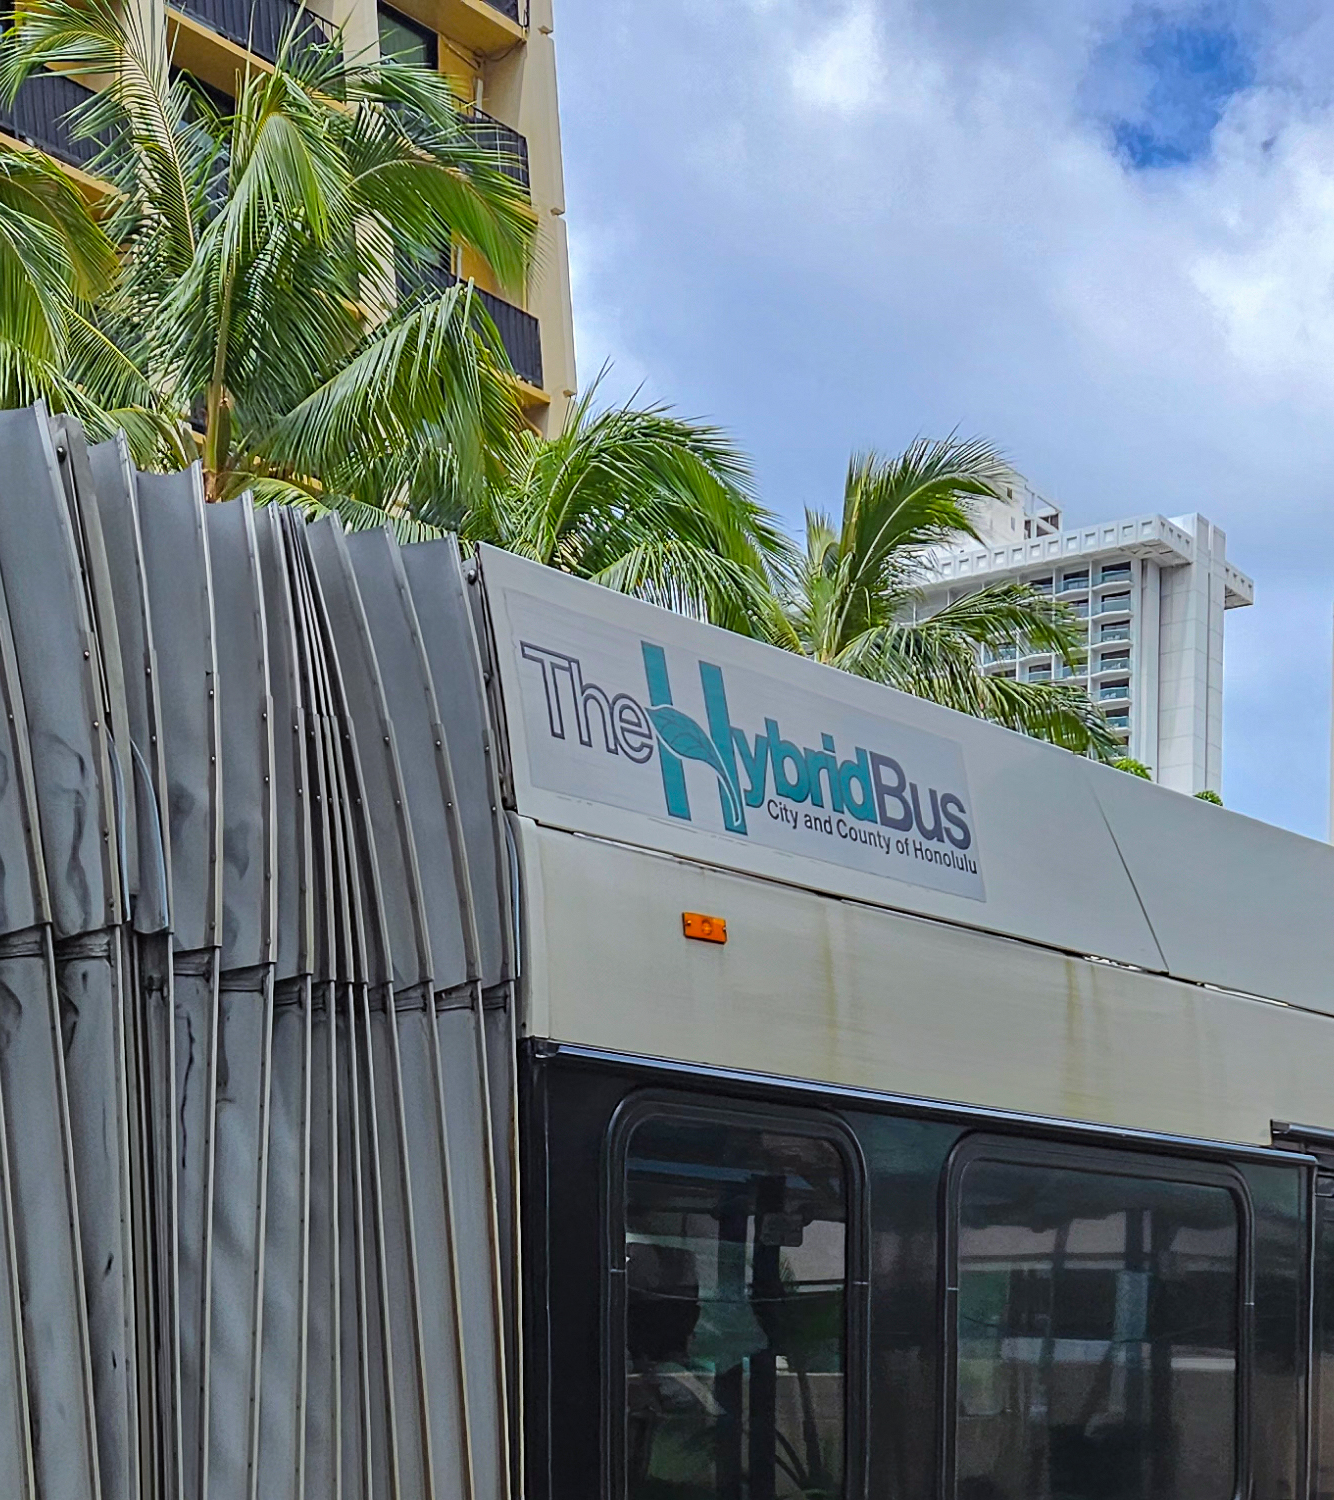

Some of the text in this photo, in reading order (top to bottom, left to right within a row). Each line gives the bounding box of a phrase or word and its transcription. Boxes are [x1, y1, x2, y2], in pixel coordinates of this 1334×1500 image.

[767, 799, 977, 874] City and County of Honolulu
